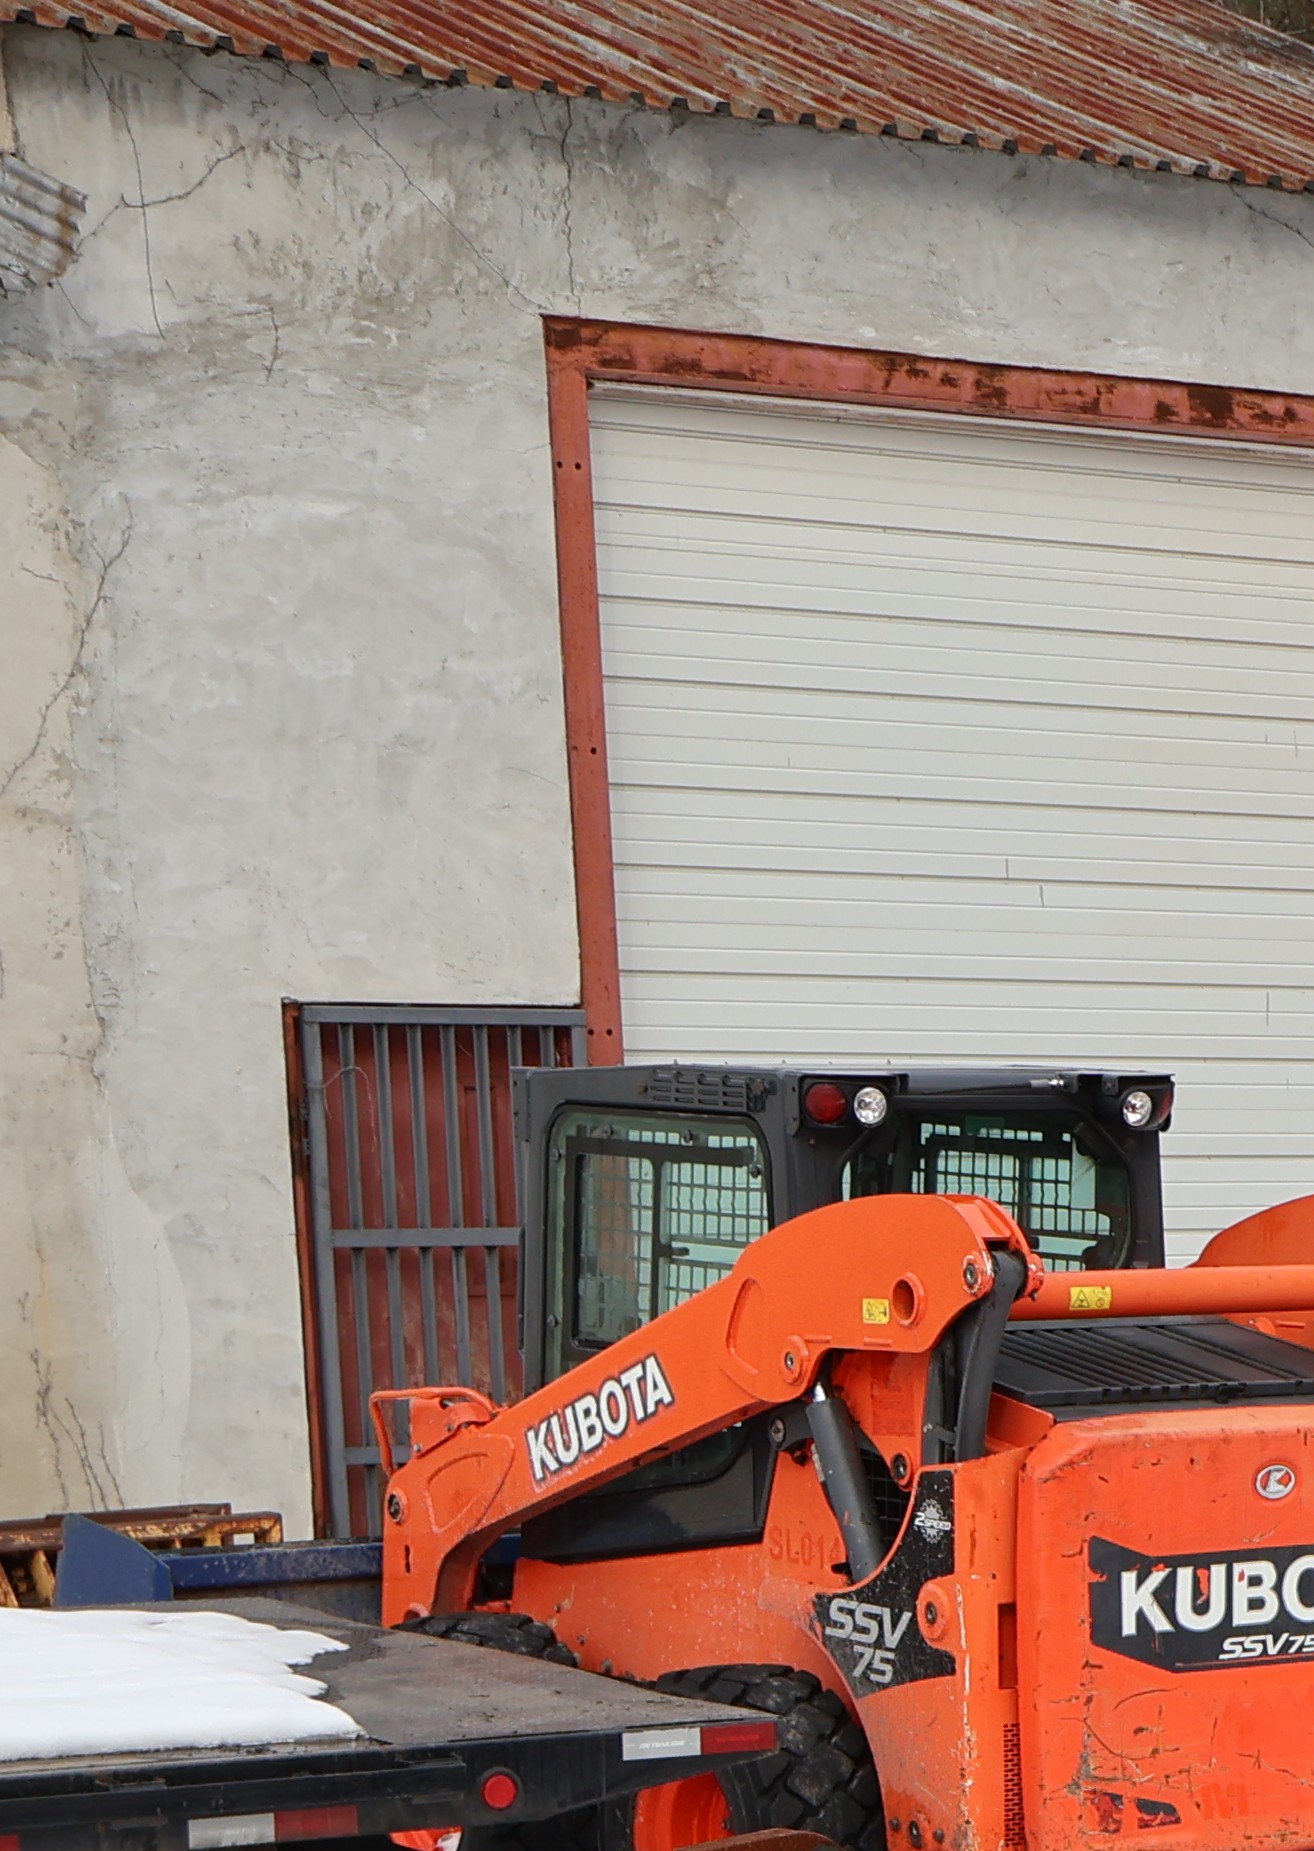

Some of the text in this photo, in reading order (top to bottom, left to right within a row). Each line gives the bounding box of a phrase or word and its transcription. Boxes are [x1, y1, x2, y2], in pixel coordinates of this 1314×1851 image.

[525, 1355, 675, 1483] KUBOTA
[824, 1598, 913, 1649] SSV
[851, 1645, 896, 1685] 75
